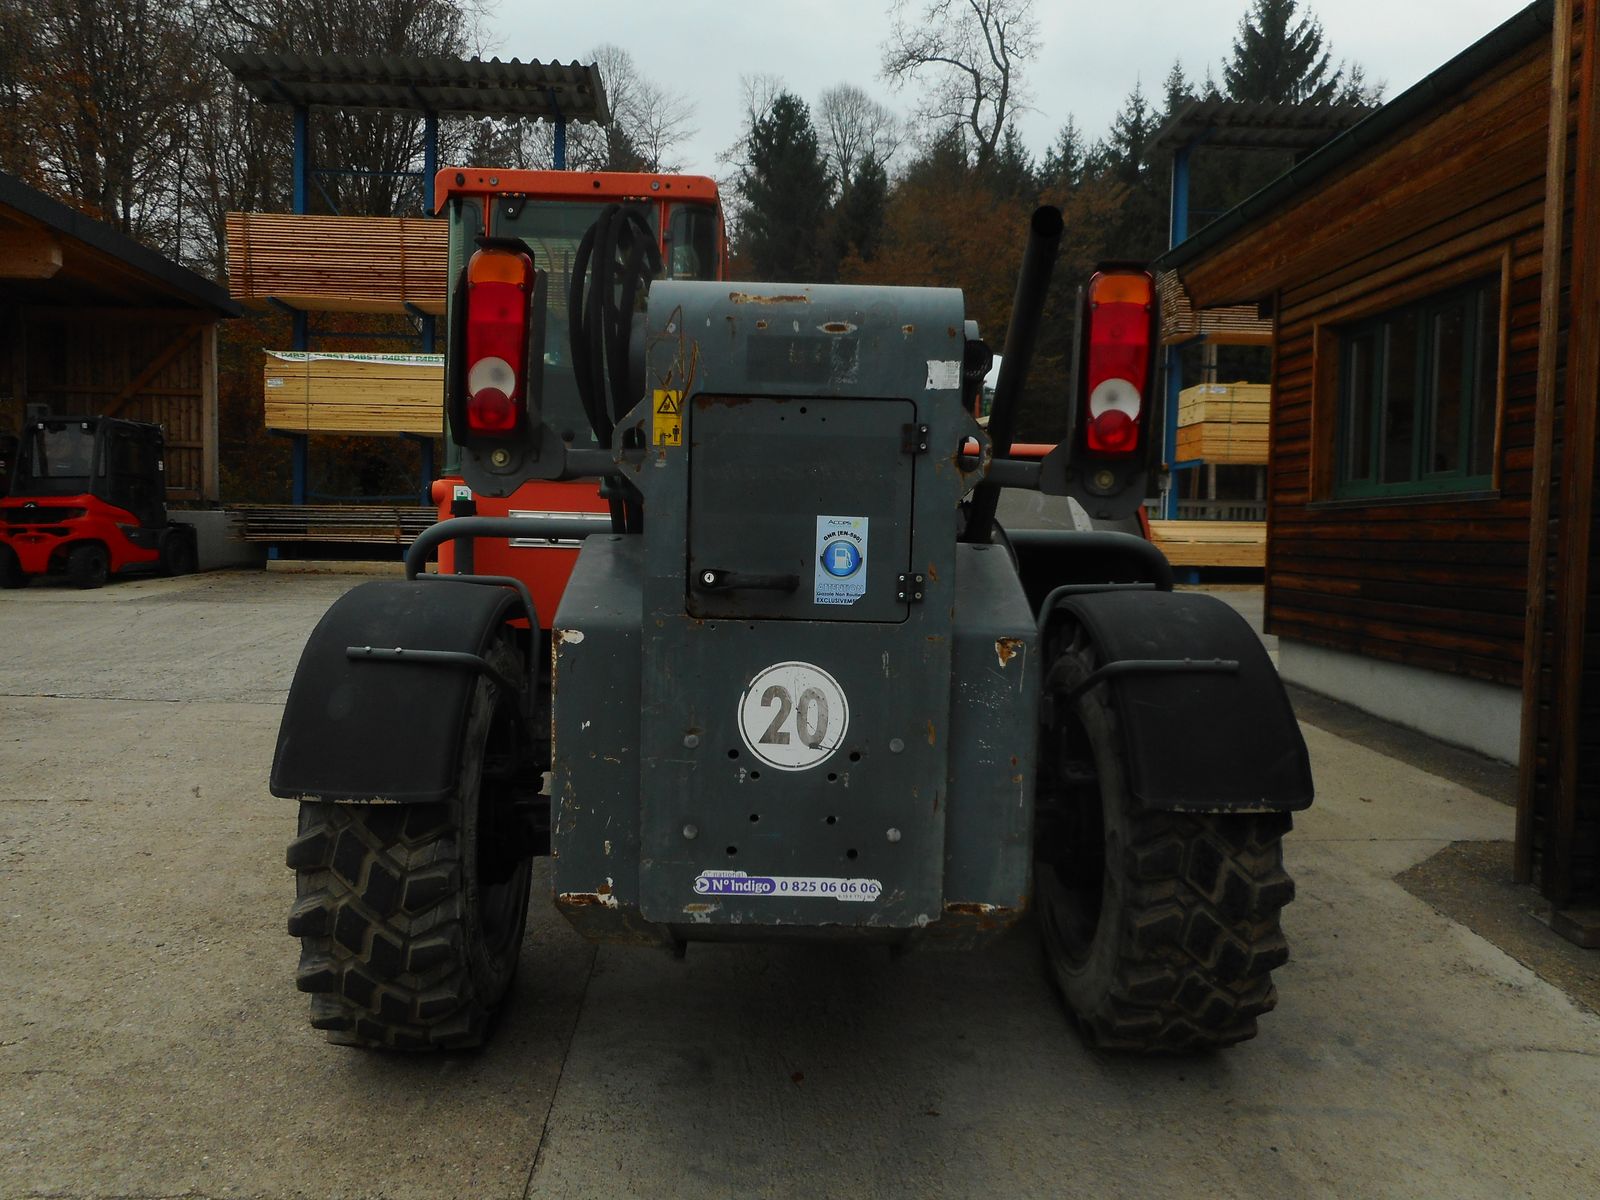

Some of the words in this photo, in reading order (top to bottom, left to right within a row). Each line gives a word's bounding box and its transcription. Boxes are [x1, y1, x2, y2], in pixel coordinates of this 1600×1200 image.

[758, 685, 829, 748] 20
[712, 879, 729, 891] N°
[731, 879, 771, 893] Indigo
[780, 881, 789, 892] 0
[791, 881, 817, 893] 825
[820, 882, 837, 893] 06
[840, 882, 857, 893] 06
[860, 882, 877, 894] 06
